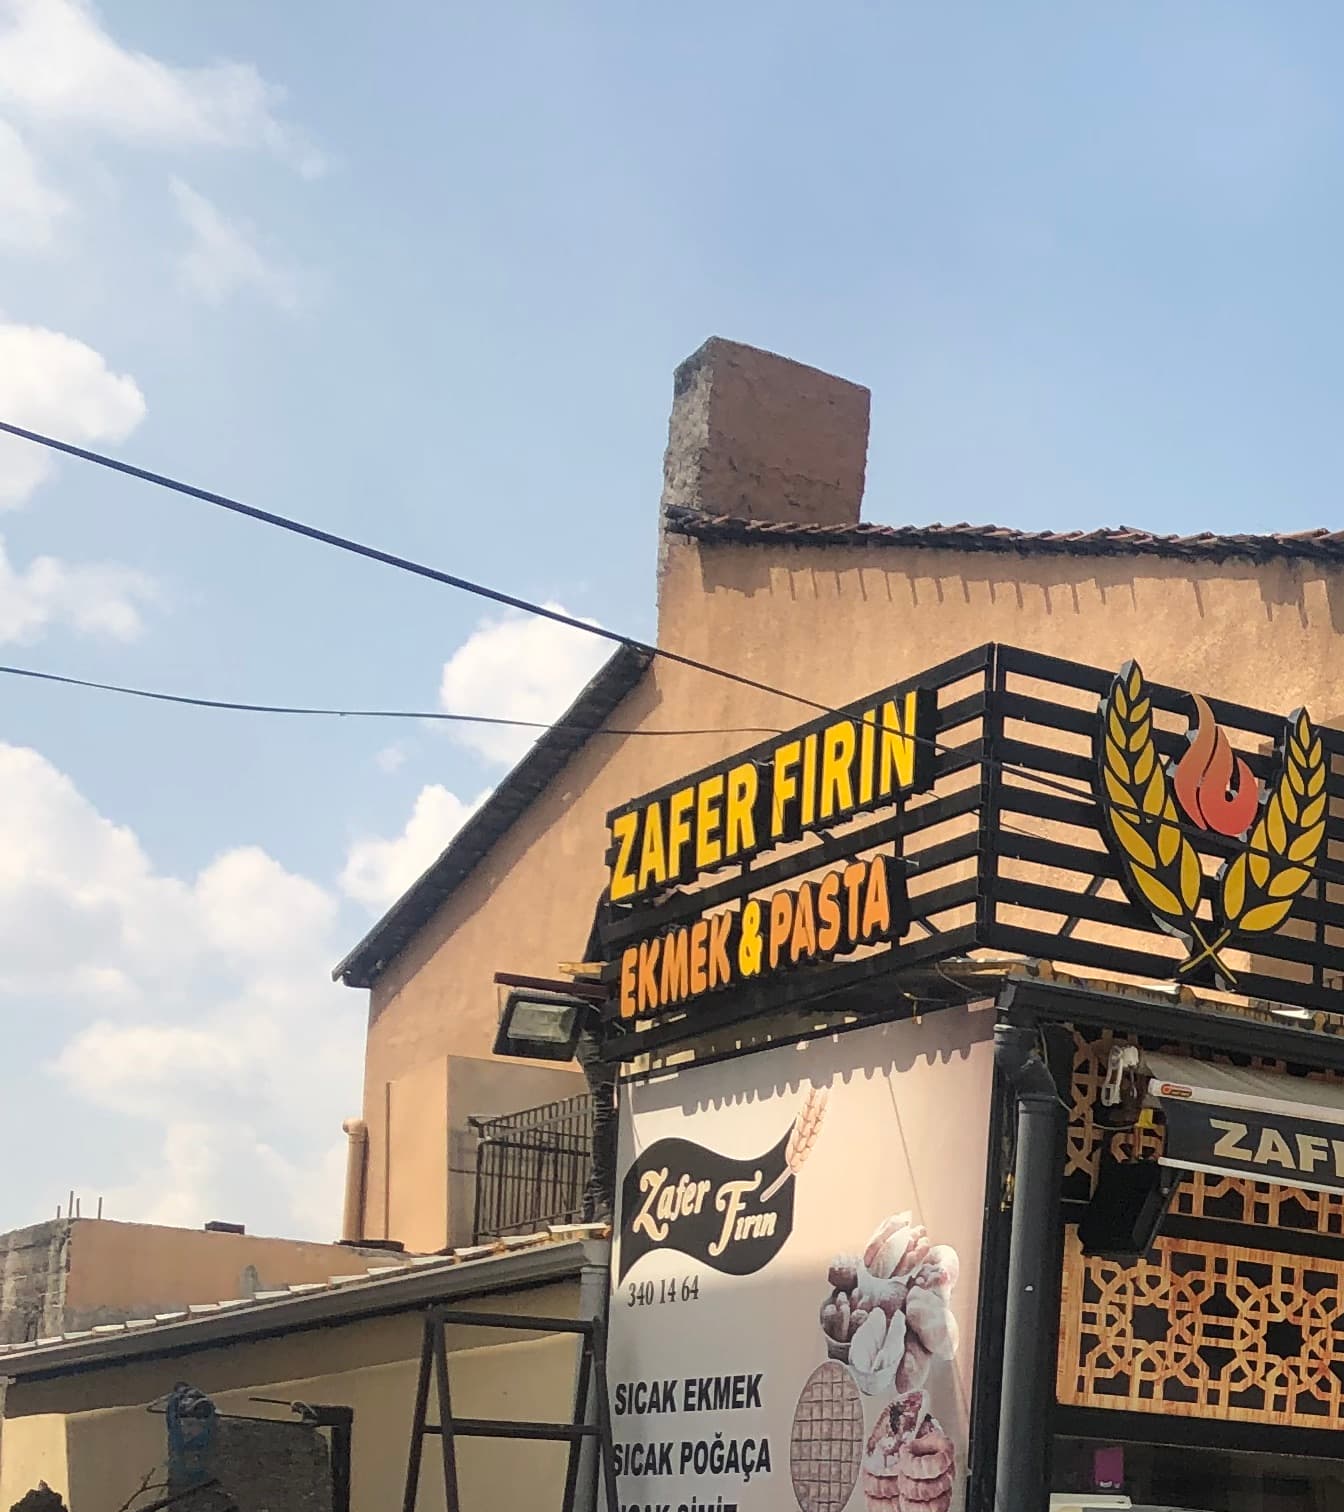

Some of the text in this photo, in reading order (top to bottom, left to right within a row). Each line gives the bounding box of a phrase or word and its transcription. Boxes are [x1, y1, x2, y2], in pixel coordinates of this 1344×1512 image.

[610, 691, 918, 902] ZAFER FIRIN
[620, 857, 889, 1018] EKMEK & PASTA
[632, 1167, 777, 1257] Zafer Fırın
[627, 1275, 700, 1308] 340 14 64
[614, 1374, 763, 1415] SICAK EKMEK
[613, 1431, 772, 1483] SICAK POĞAÇA
